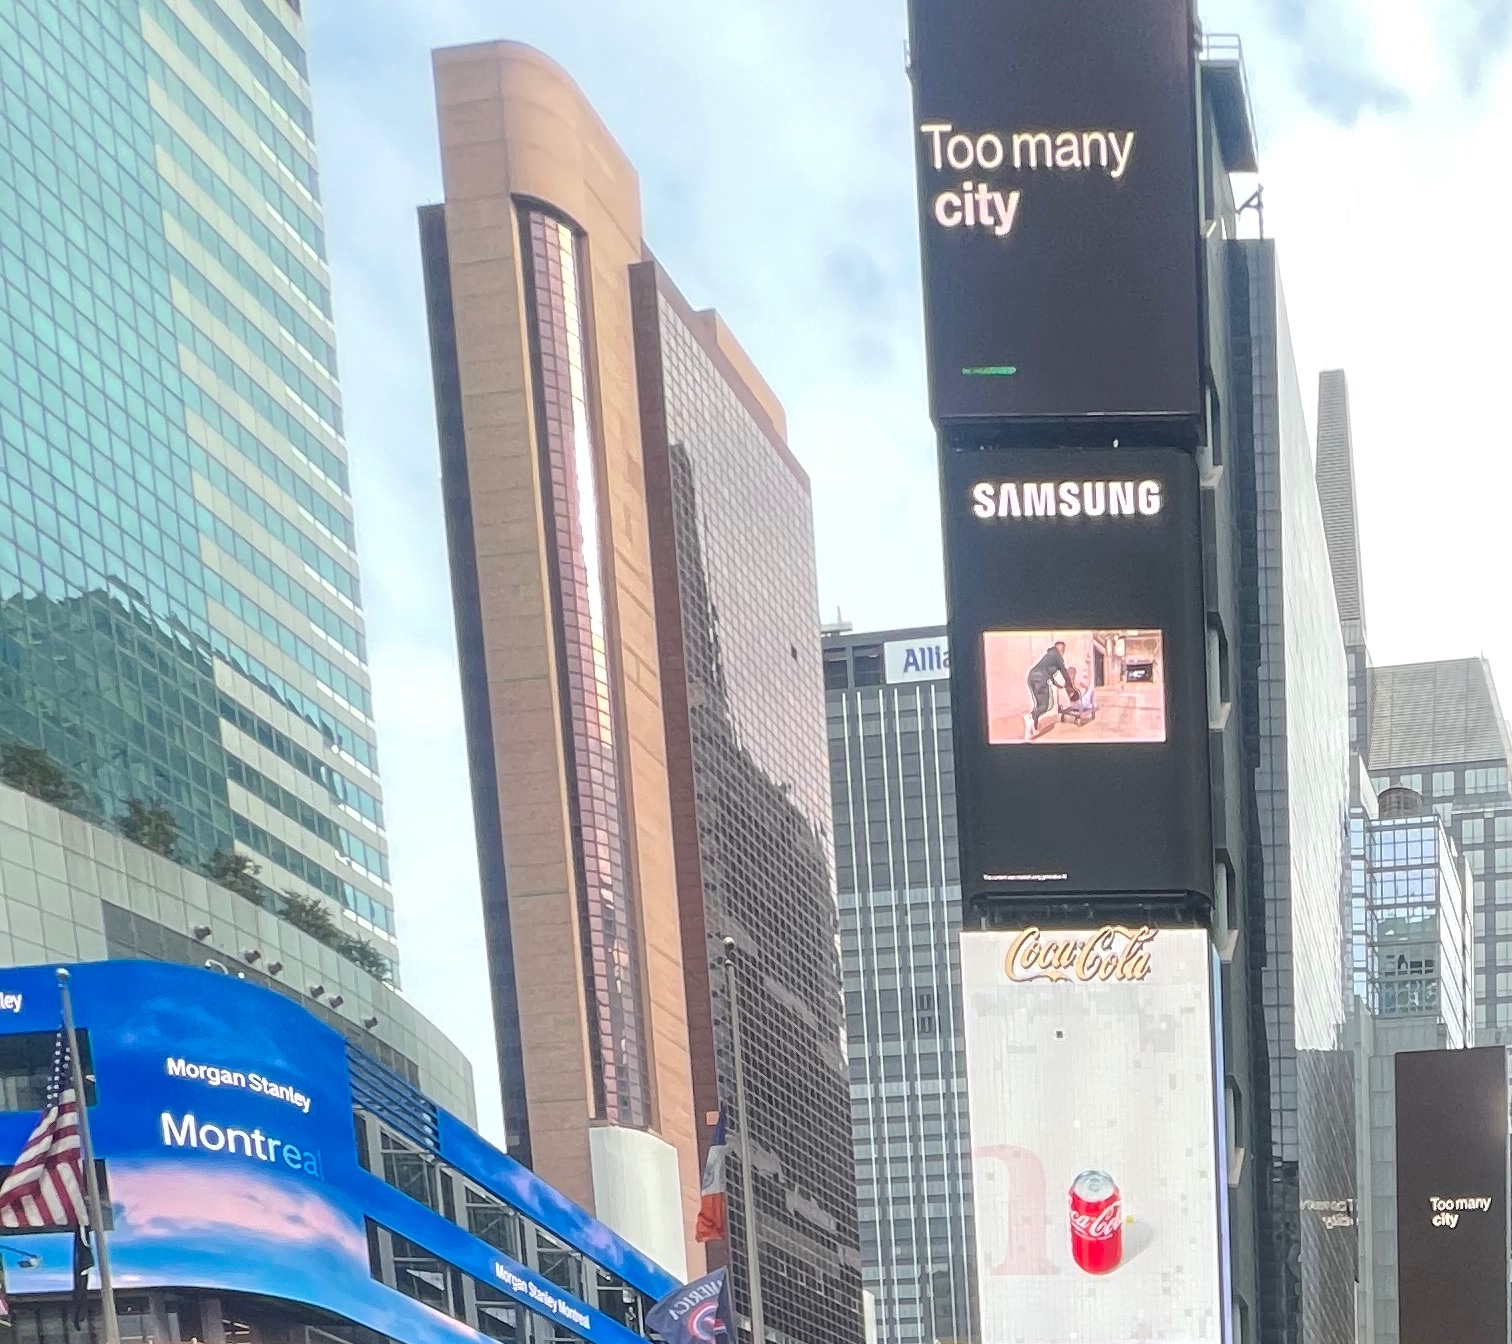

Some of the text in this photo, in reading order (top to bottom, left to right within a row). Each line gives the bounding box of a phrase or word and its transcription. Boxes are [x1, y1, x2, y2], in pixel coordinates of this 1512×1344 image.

[921, 124, 1134, 177] Too many
[935, 182, 1020, 235] city
[972, 480, 1162, 518] SAMSUNG
[166, 1057, 311, 1113] Morgan Stanley
[161, 1112, 325, 1181] Montreal
[1430, 1196, 1492, 1212] Too many
[1432, 1212, 1459, 1228] city
[495, 1262, 528, 1292] Morgan
